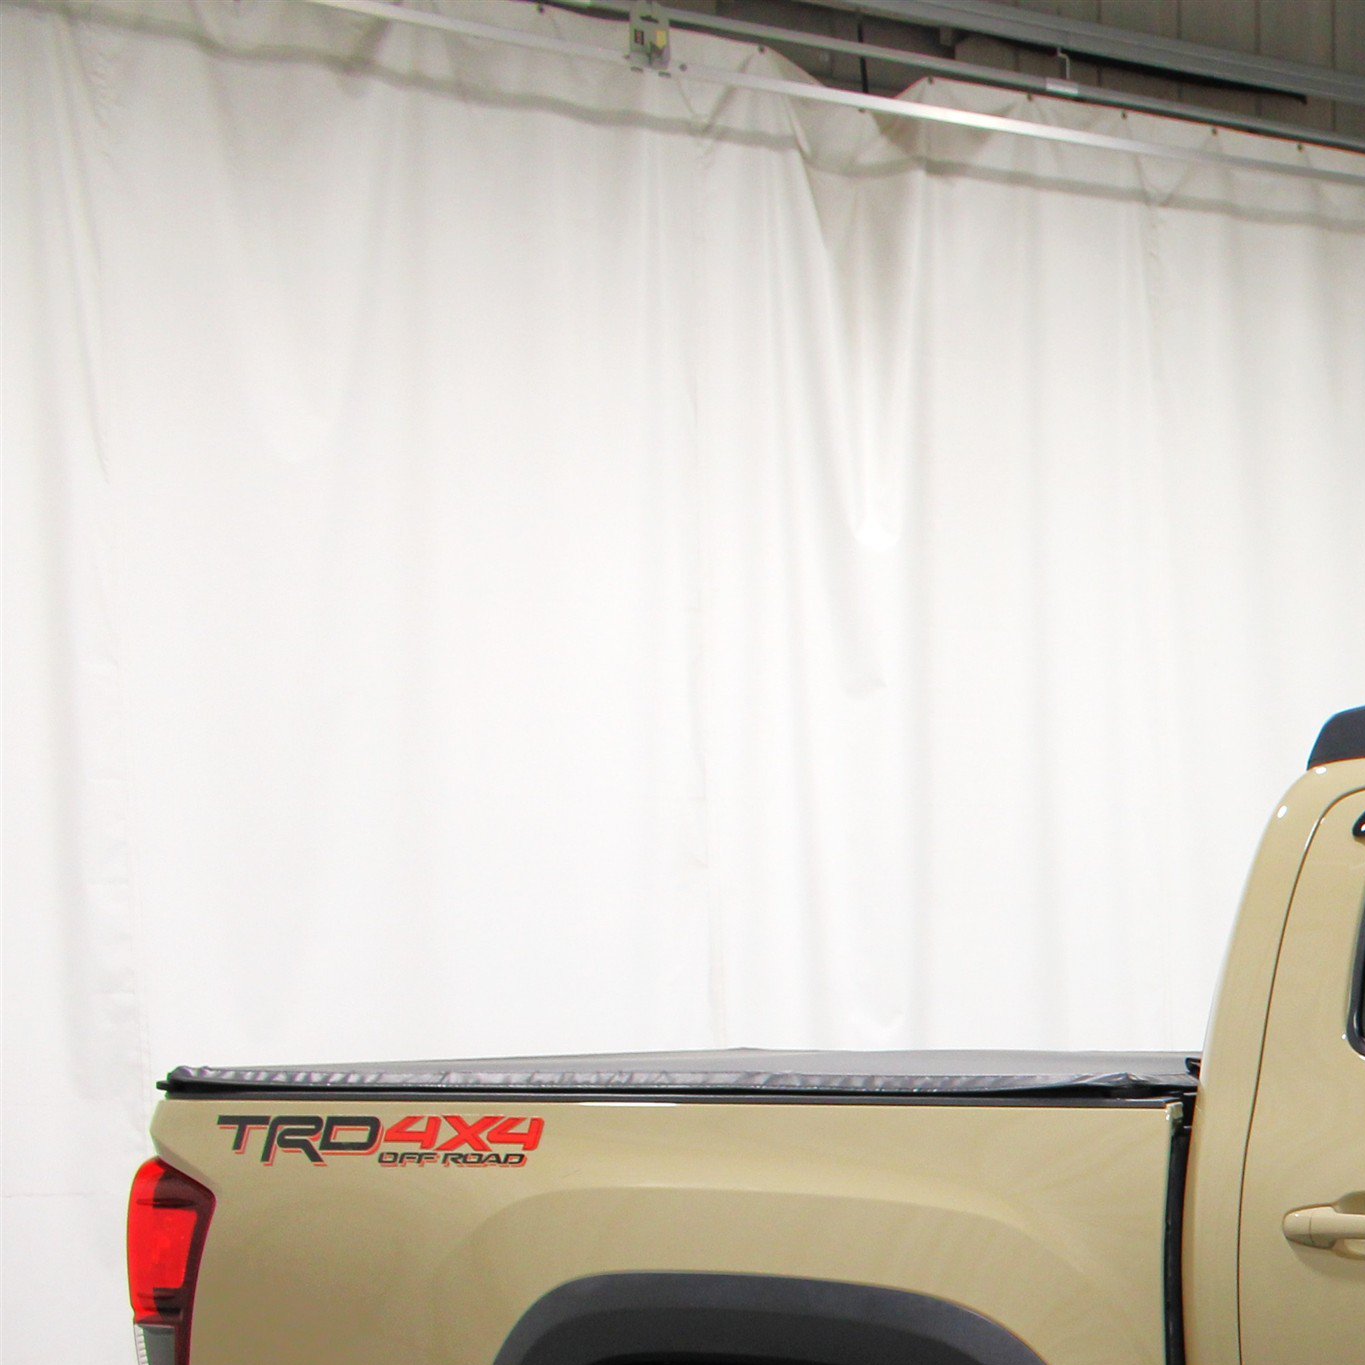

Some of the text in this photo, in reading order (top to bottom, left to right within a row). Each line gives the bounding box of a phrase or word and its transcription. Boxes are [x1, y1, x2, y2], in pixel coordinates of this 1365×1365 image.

[217, 1115, 385, 1167] TRD
[377, 1152, 528, 1168] OFF ROAD
